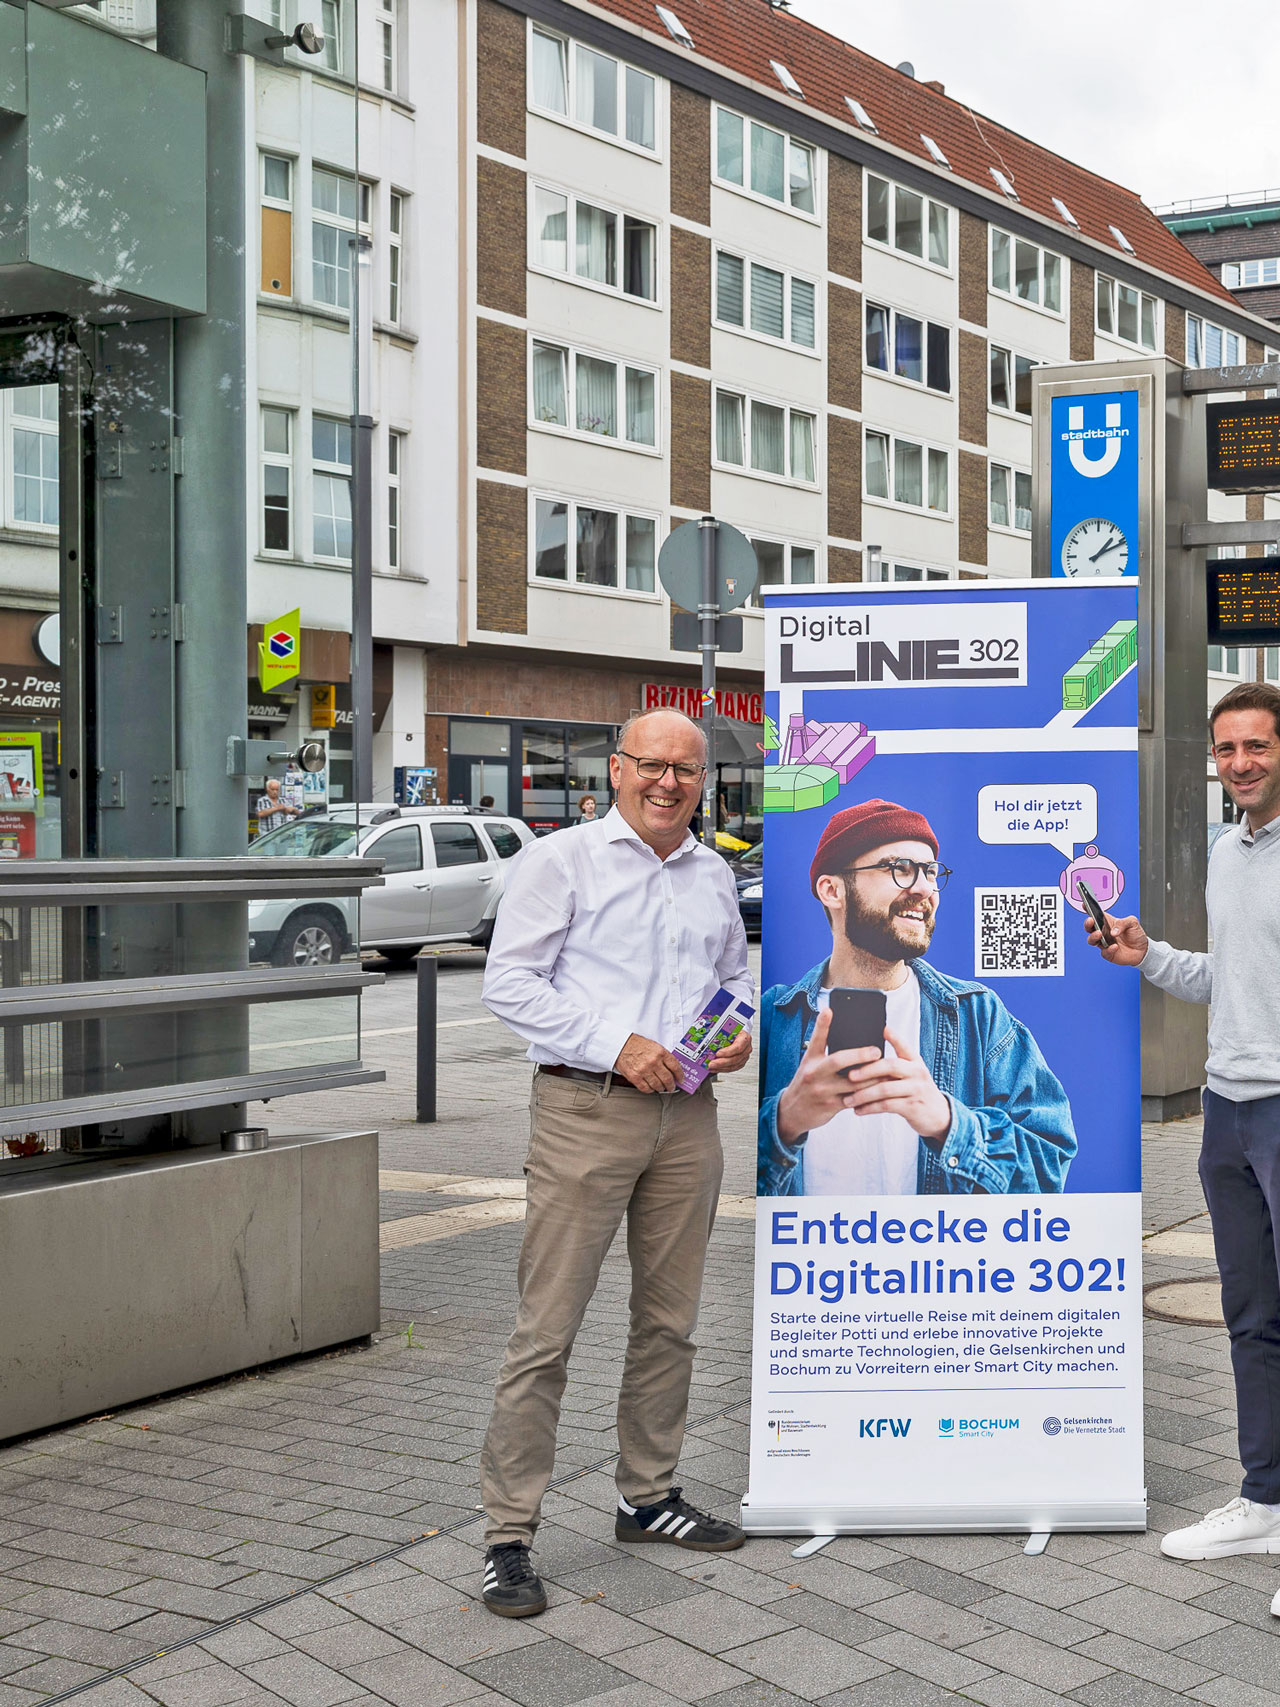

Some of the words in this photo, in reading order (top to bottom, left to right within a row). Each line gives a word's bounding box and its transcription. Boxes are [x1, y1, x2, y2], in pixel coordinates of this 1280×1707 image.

[1061, 428, 1129, 440] stadtbahn
[780, 615, 870, 642] Digital
[780, 640, 1019, 683] LINIE
[969, 639, 1019, 661] 302
[646, 683, 703, 718] BiZiM
[715, 690, 764, 724] ANG
[994, 801, 1019, 812] Hol
[1024, 800, 1043, 811] dir
[1046, 800, 1082, 813] jetzt
[1007, 819, 1030, 831] die
[1033, 818, 1069, 832] App!
[771, 1209, 987, 1245] Entdecke
[1002, 1207, 1071, 1243] die
[770, 1258, 1015, 1304] Digitallinie
[1028, 1257, 1126, 1294] 302!
[770, 1312, 816, 1324] Starte
[820, 1311, 861, 1323] deine
[865, 1310, 924, 1323] virtuelle
[928, 1310, 968, 1322] Reise
[972, 1309, 996, 1321] mit
[1000, 1309, 1053, 1321] deinem
[1057, 1308, 1120, 1323] digitalen
[770, 1328, 838, 1344] Begleiter
[842, 1328, 877, 1340] Potti
[881, 1328, 909, 1340] und
[913, 1327, 959, 1339] erlebe
[963, 1326, 1038, 1339] innovative
[1042, 1326, 1103, 1340] Projekte
[769, 1347, 798, 1358] und
[802, 1346, 854, 1358] smarte
[857, 1344, 960, 1359] Technologien,
[963, 1344, 985, 1356] die
[989, 1342, 1094, 1356] Gelsenkirchen
[1097, 1342, 1125, 1354] und
[769, 1363, 831, 1376] Bochum
[835, 1365, 851, 1375] zu
[855, 1361, 930, 1375] Vorreitern
[933, 1361, 970, 1373] einer
[974, 1361, 1019, 1373] Smart
[1023, 1360, 1053, 1375] City
[1057, 1360, 1119, 1373] machen.
[859, 1418, 912, 1438] KFW
[959, 1418, 1020, 1430] BOCHUM
[1063, 1417, 1113, 1425] Gelsenkirchen
[981, 1430, 995, 1438] City
[1063, 1426, 1075, 1434] Die
[1076, 1426, 1107, 1434] Vernetzte
[1108, 1425, 1126, 1434] Stadt
